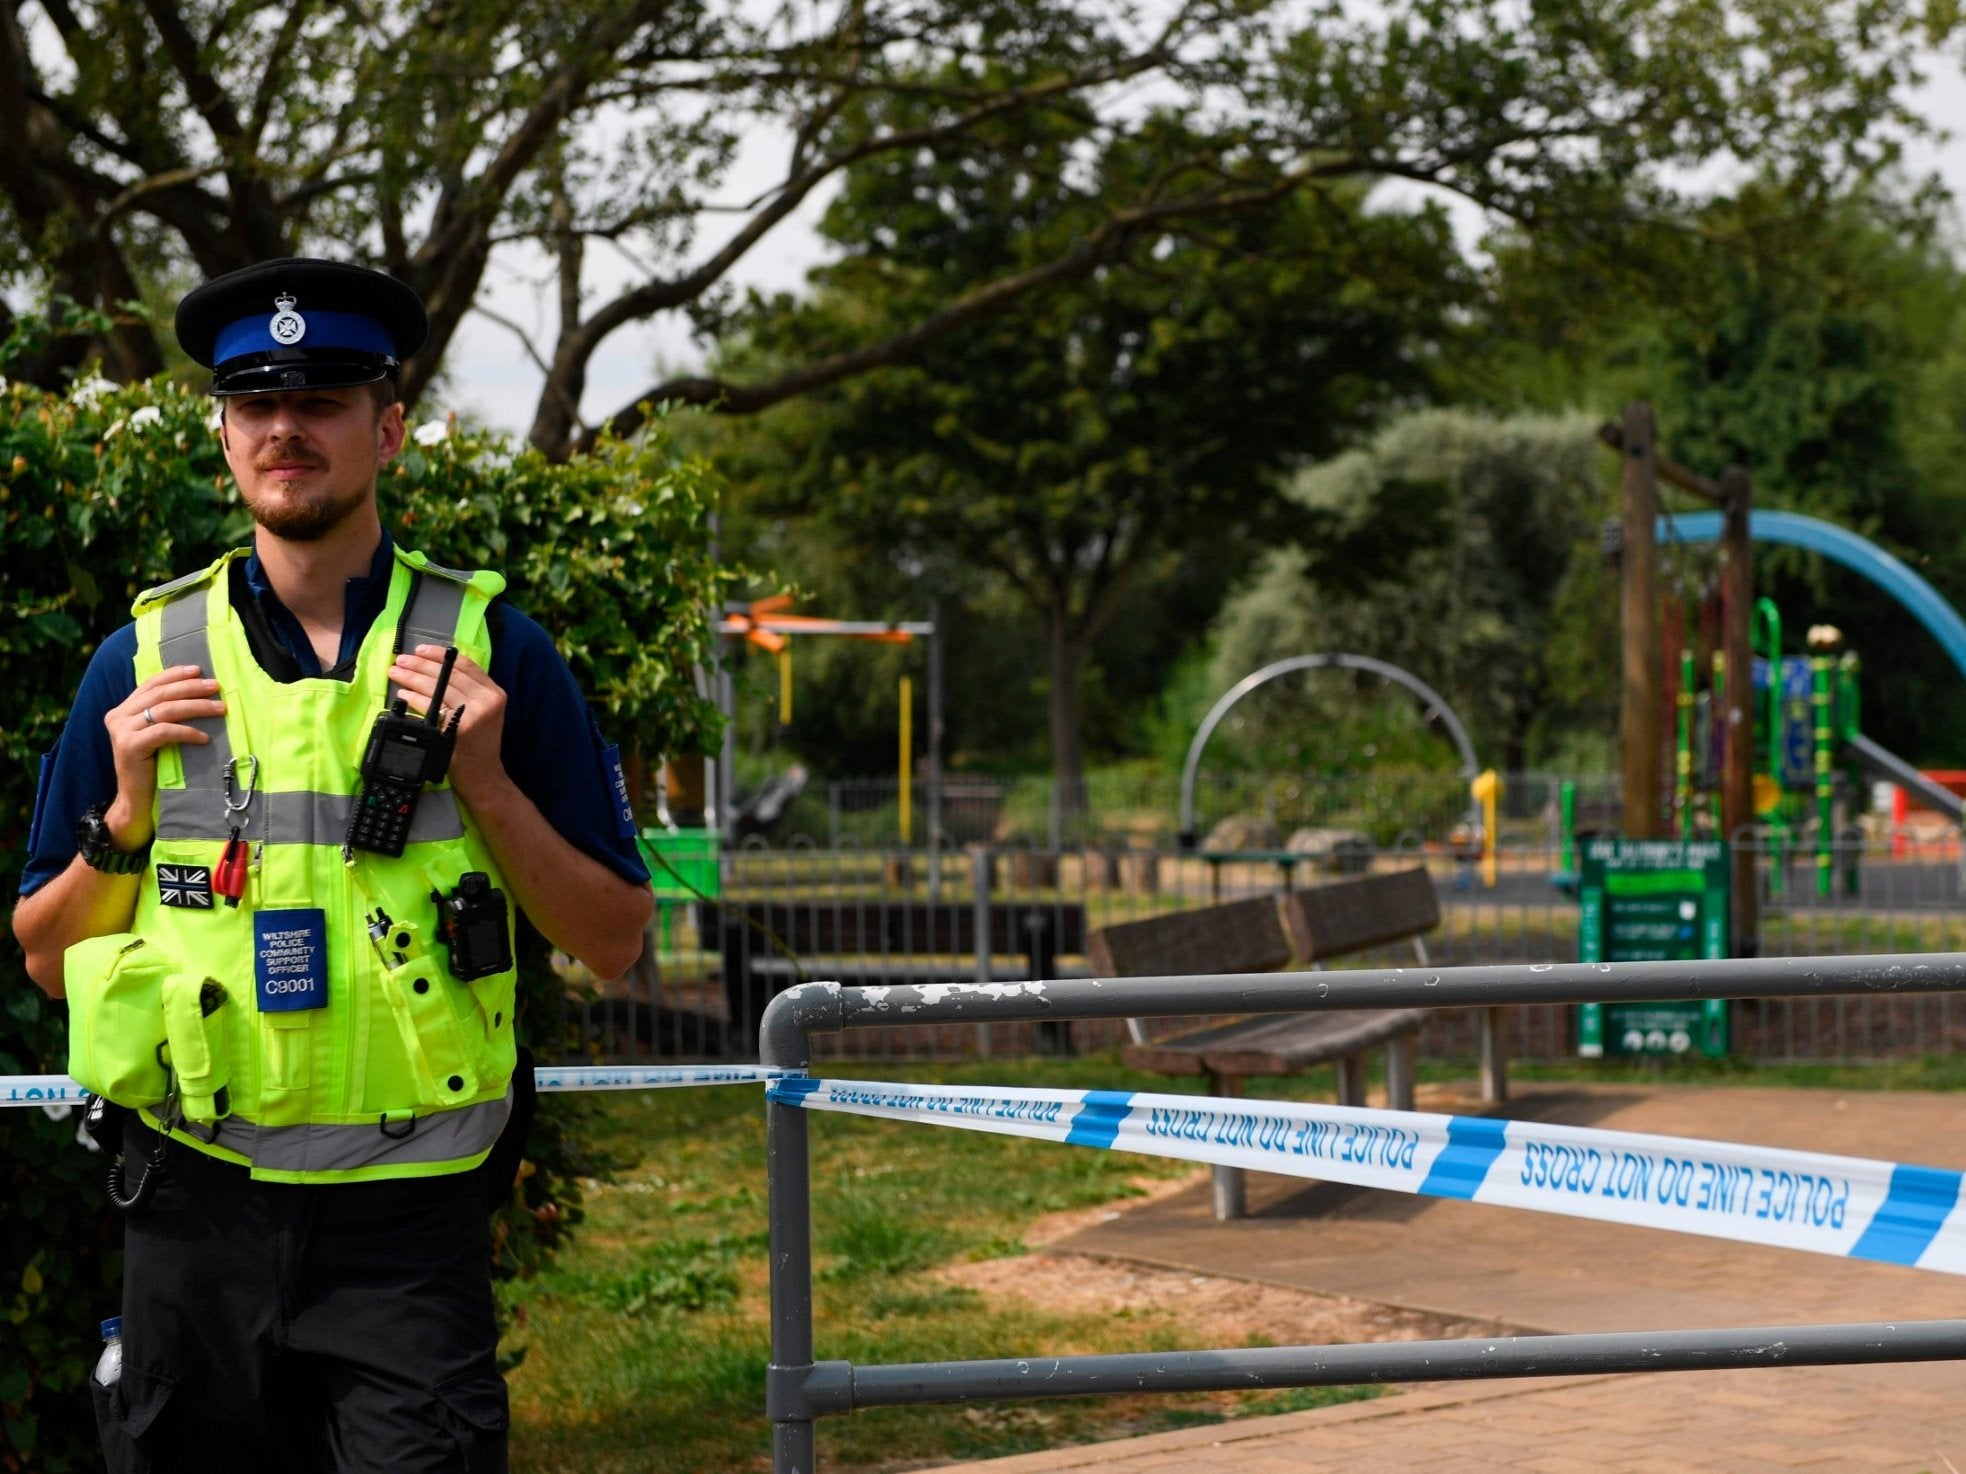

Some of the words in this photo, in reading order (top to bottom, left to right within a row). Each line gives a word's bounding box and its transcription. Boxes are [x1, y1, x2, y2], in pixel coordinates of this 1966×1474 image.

[262, 928, 312, 940] WILTSHIRE
[270, 938, 305, 948] POLICE
[259, 946, 315, 958] COMMUNITY
[266, 955, 311, 966] SUPPORT
[268, 964, 310, 975] OFFICER
[265, 977, 315, 994] C9001
[995, 1099, 1063, 1122] POLICE
[1146, 1107, 1214, 1142] CROSS
[1215, 1113, 1258, 1148] NOT
[1259, 1116, 1292, 1152] DO
[1293, 1120, 1340, 1159] LINE
[1342, 1123, 1419, 1169] POLICE
[1521, 1141, 1600, 1194] CROSS
[1602, 1152, 1654, 1201] NOT
[1657, 1157, 1694, 1207] DO
[1697, 1161, 1753, 1215] LINE
[1756, 1169, 1849, 1229] POLICE
